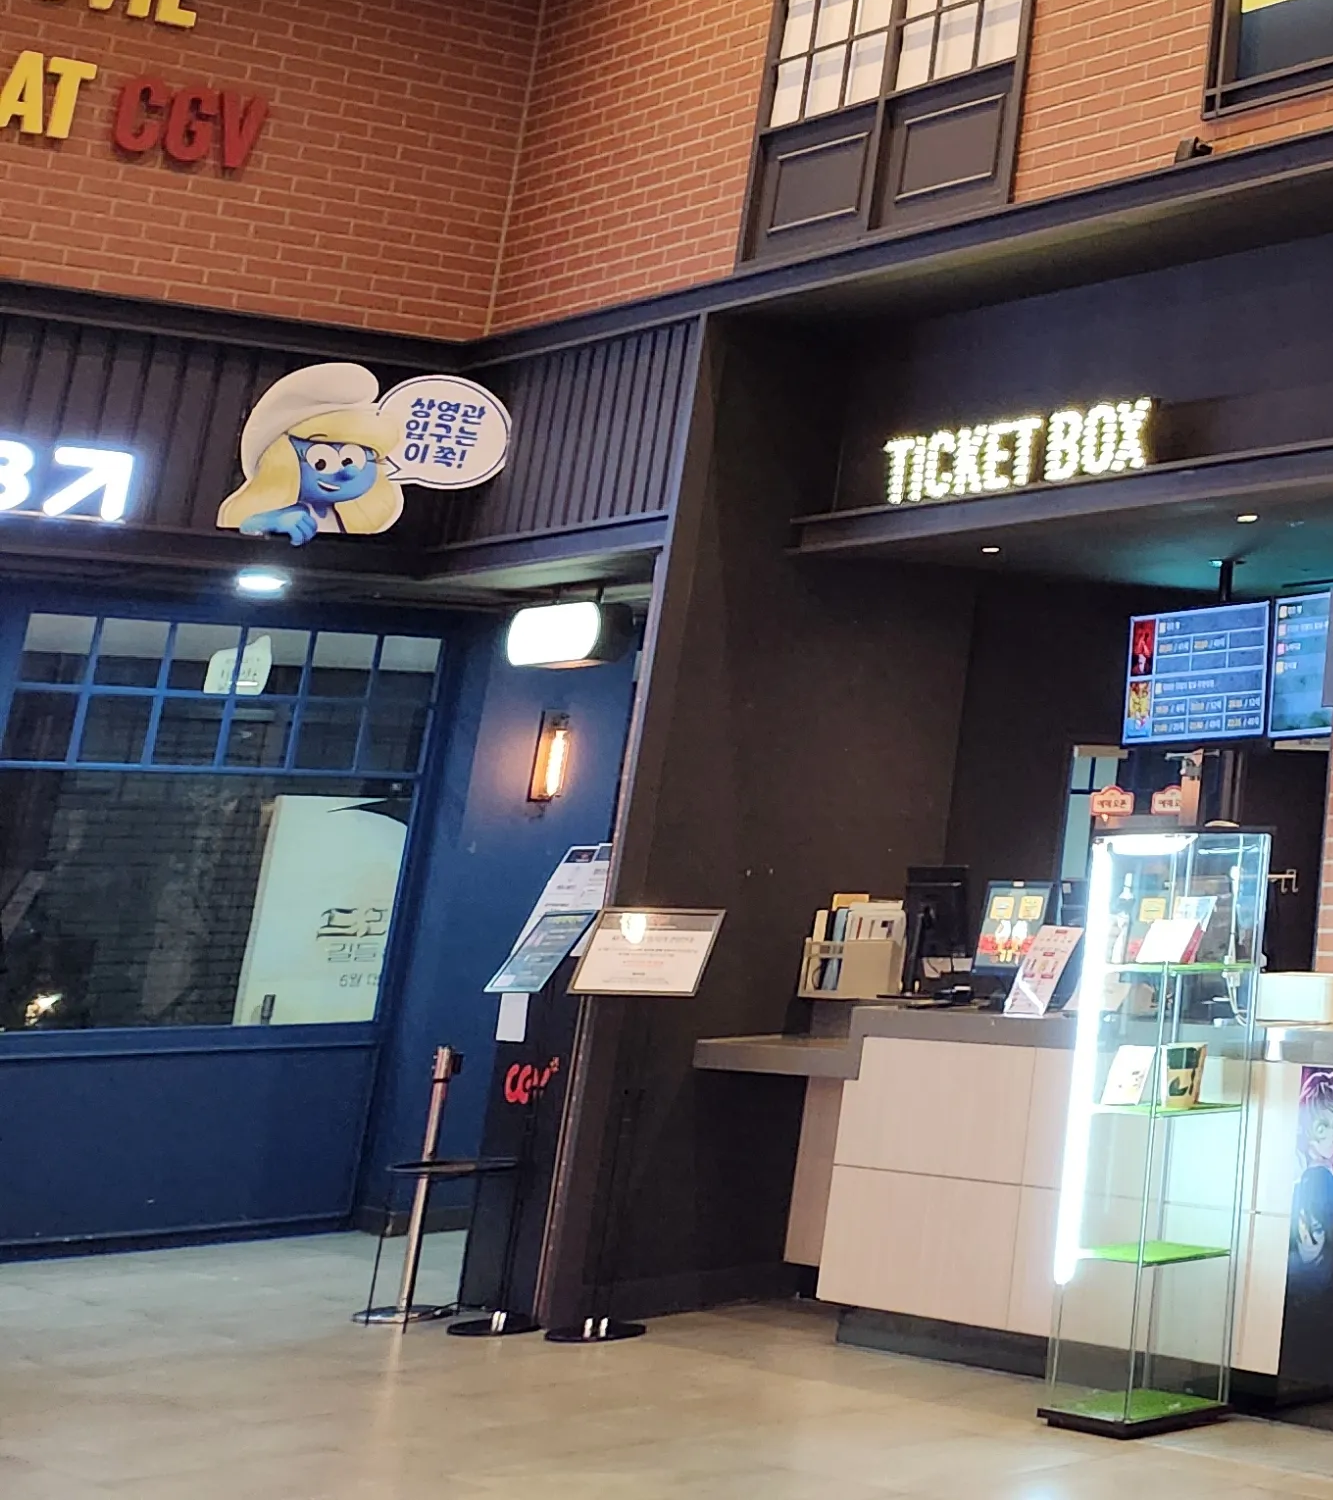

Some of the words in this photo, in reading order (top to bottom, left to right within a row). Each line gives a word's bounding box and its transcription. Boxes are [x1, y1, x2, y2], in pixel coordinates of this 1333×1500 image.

[0, 50, 97, 140] AT
[111, 75, 269, 169] CGV
[411, 398, 486, 425] 상영관
[406, 420, 478, 447] 입구는
[405, 443, 430, 463] 이
[433, 446, 467, 469] 쪽!
[883, 416, 1043, 504] TICKET
[1044, 397, 1152, 481] BOX
